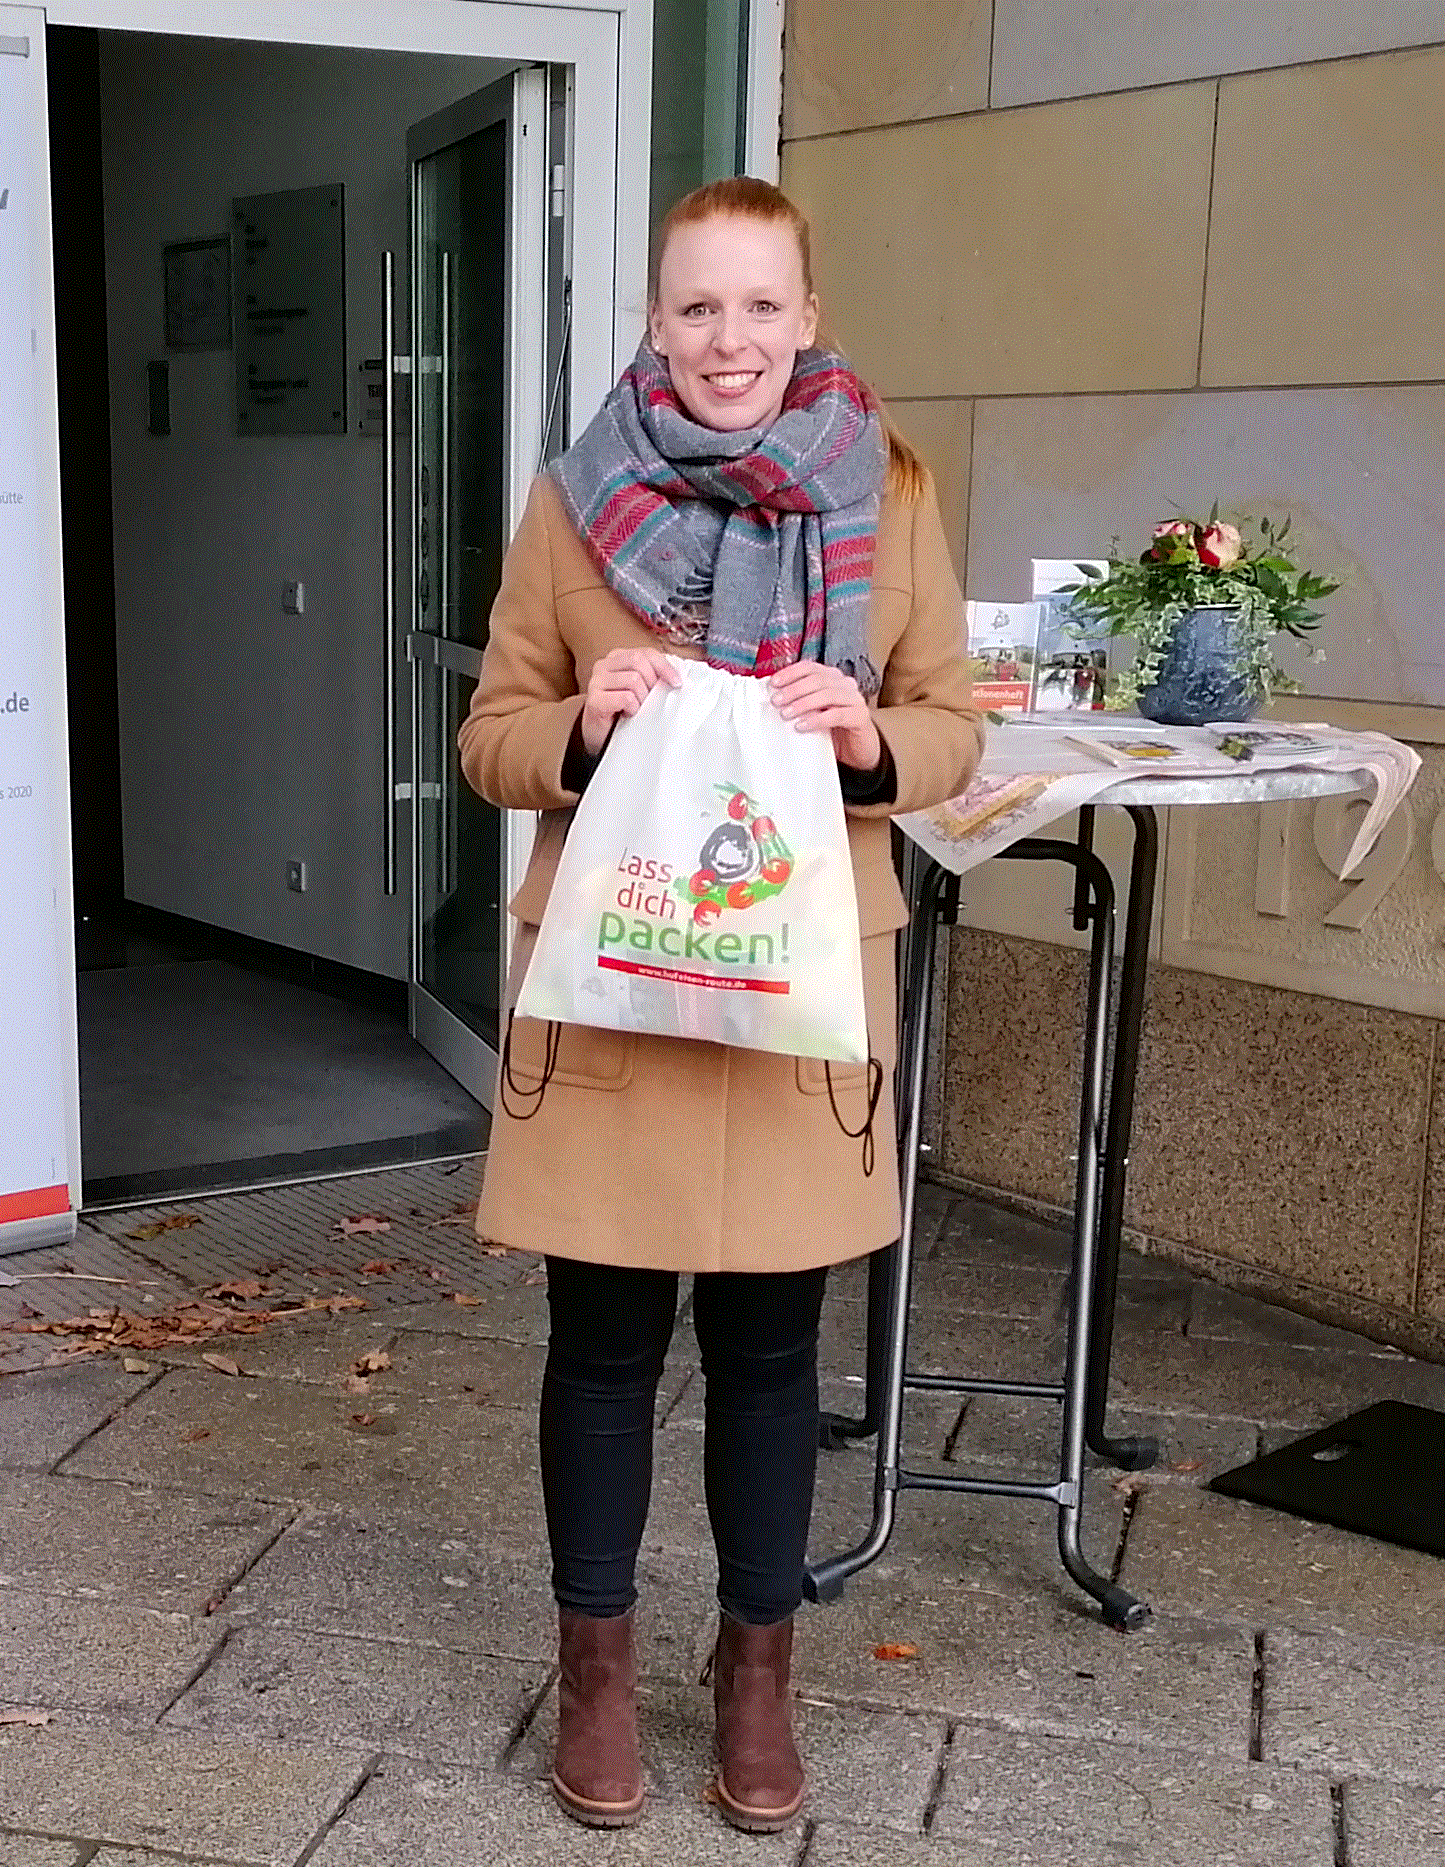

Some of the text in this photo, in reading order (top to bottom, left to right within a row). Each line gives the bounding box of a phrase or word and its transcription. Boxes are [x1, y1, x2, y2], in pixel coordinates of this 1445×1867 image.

[7, 785, 33, 799] 2020
[617, 847, 674, 884] Lass
[617, 881, 676, 920] dich
[598, 911, 790, 965] packen!
